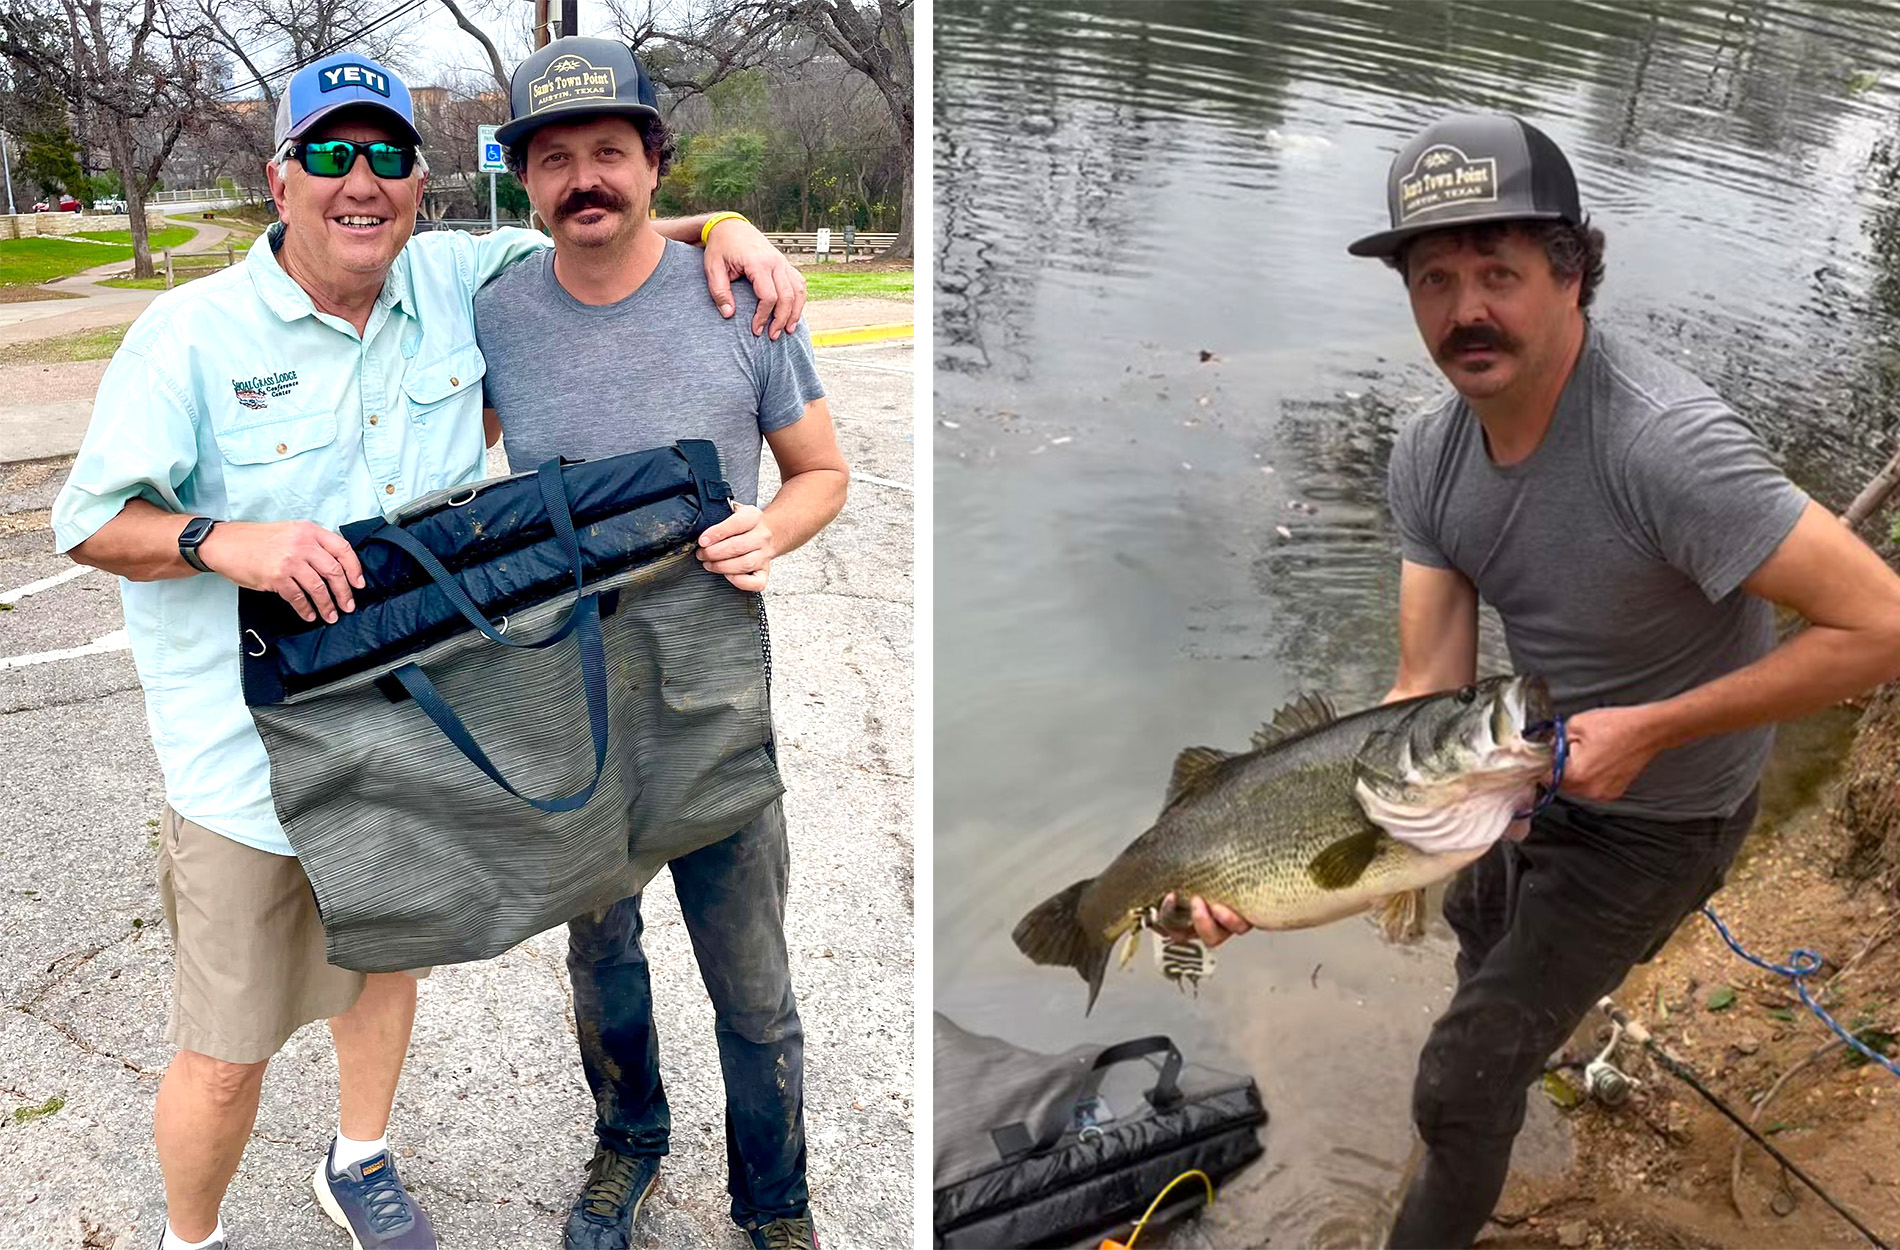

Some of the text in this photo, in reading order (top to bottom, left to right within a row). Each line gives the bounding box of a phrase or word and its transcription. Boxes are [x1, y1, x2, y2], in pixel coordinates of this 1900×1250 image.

[324, 67, 384, 91] YETI
[533, 72, 609, 97] Sam's Town Point
[538, 87, 605, 105] AUSTIN, TEXAS
[1423, 174, 1454, 191] Town
[1455, 167, 1488, 185] Point
[1445, 187, 1482, 198] TEXAS
[266, 381, 299, 392] Conference
[273, 371, 297, 384] LODGE
